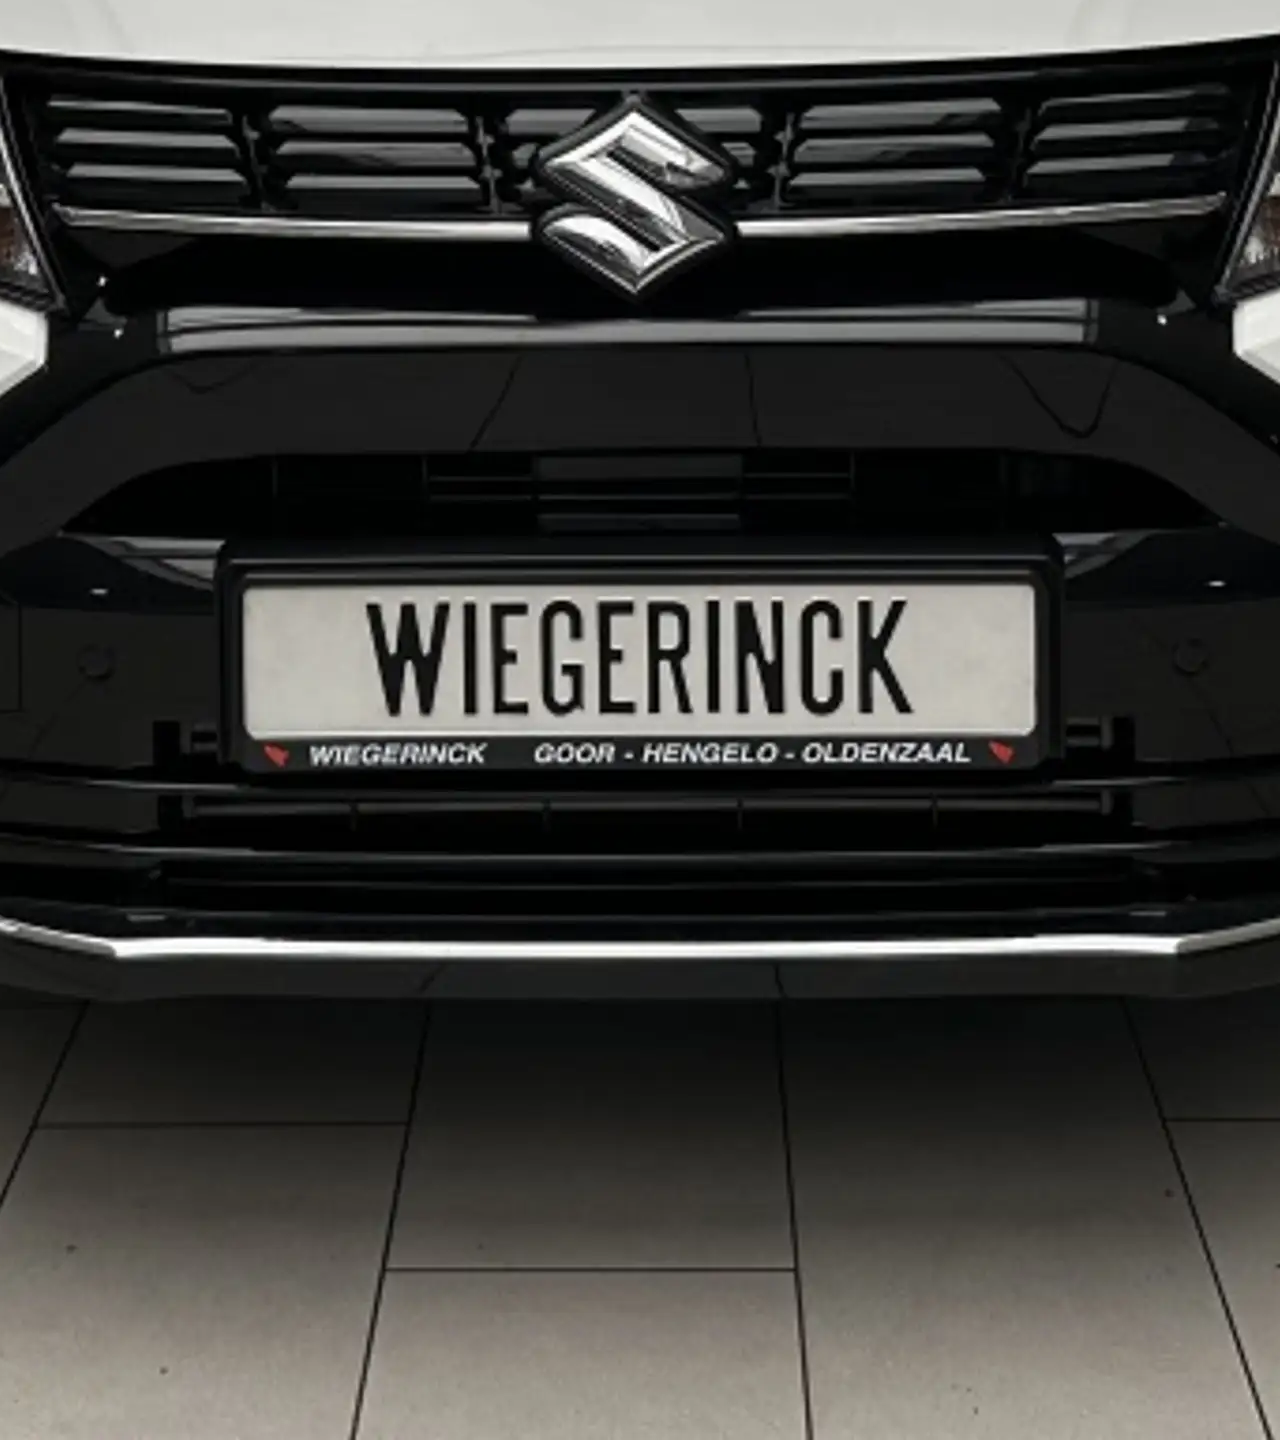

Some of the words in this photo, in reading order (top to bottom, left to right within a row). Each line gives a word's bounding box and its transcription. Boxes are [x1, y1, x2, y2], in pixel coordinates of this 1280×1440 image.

[366, 600, 912, 717] WIEGERINCK
[310, 743, 487, 765] WIEGERINCK
[535, 743, 615, 763] GOOR
[642, 743, 779, 763] HENGELO
[802, 743, 971, 763] OLDENZAAL
